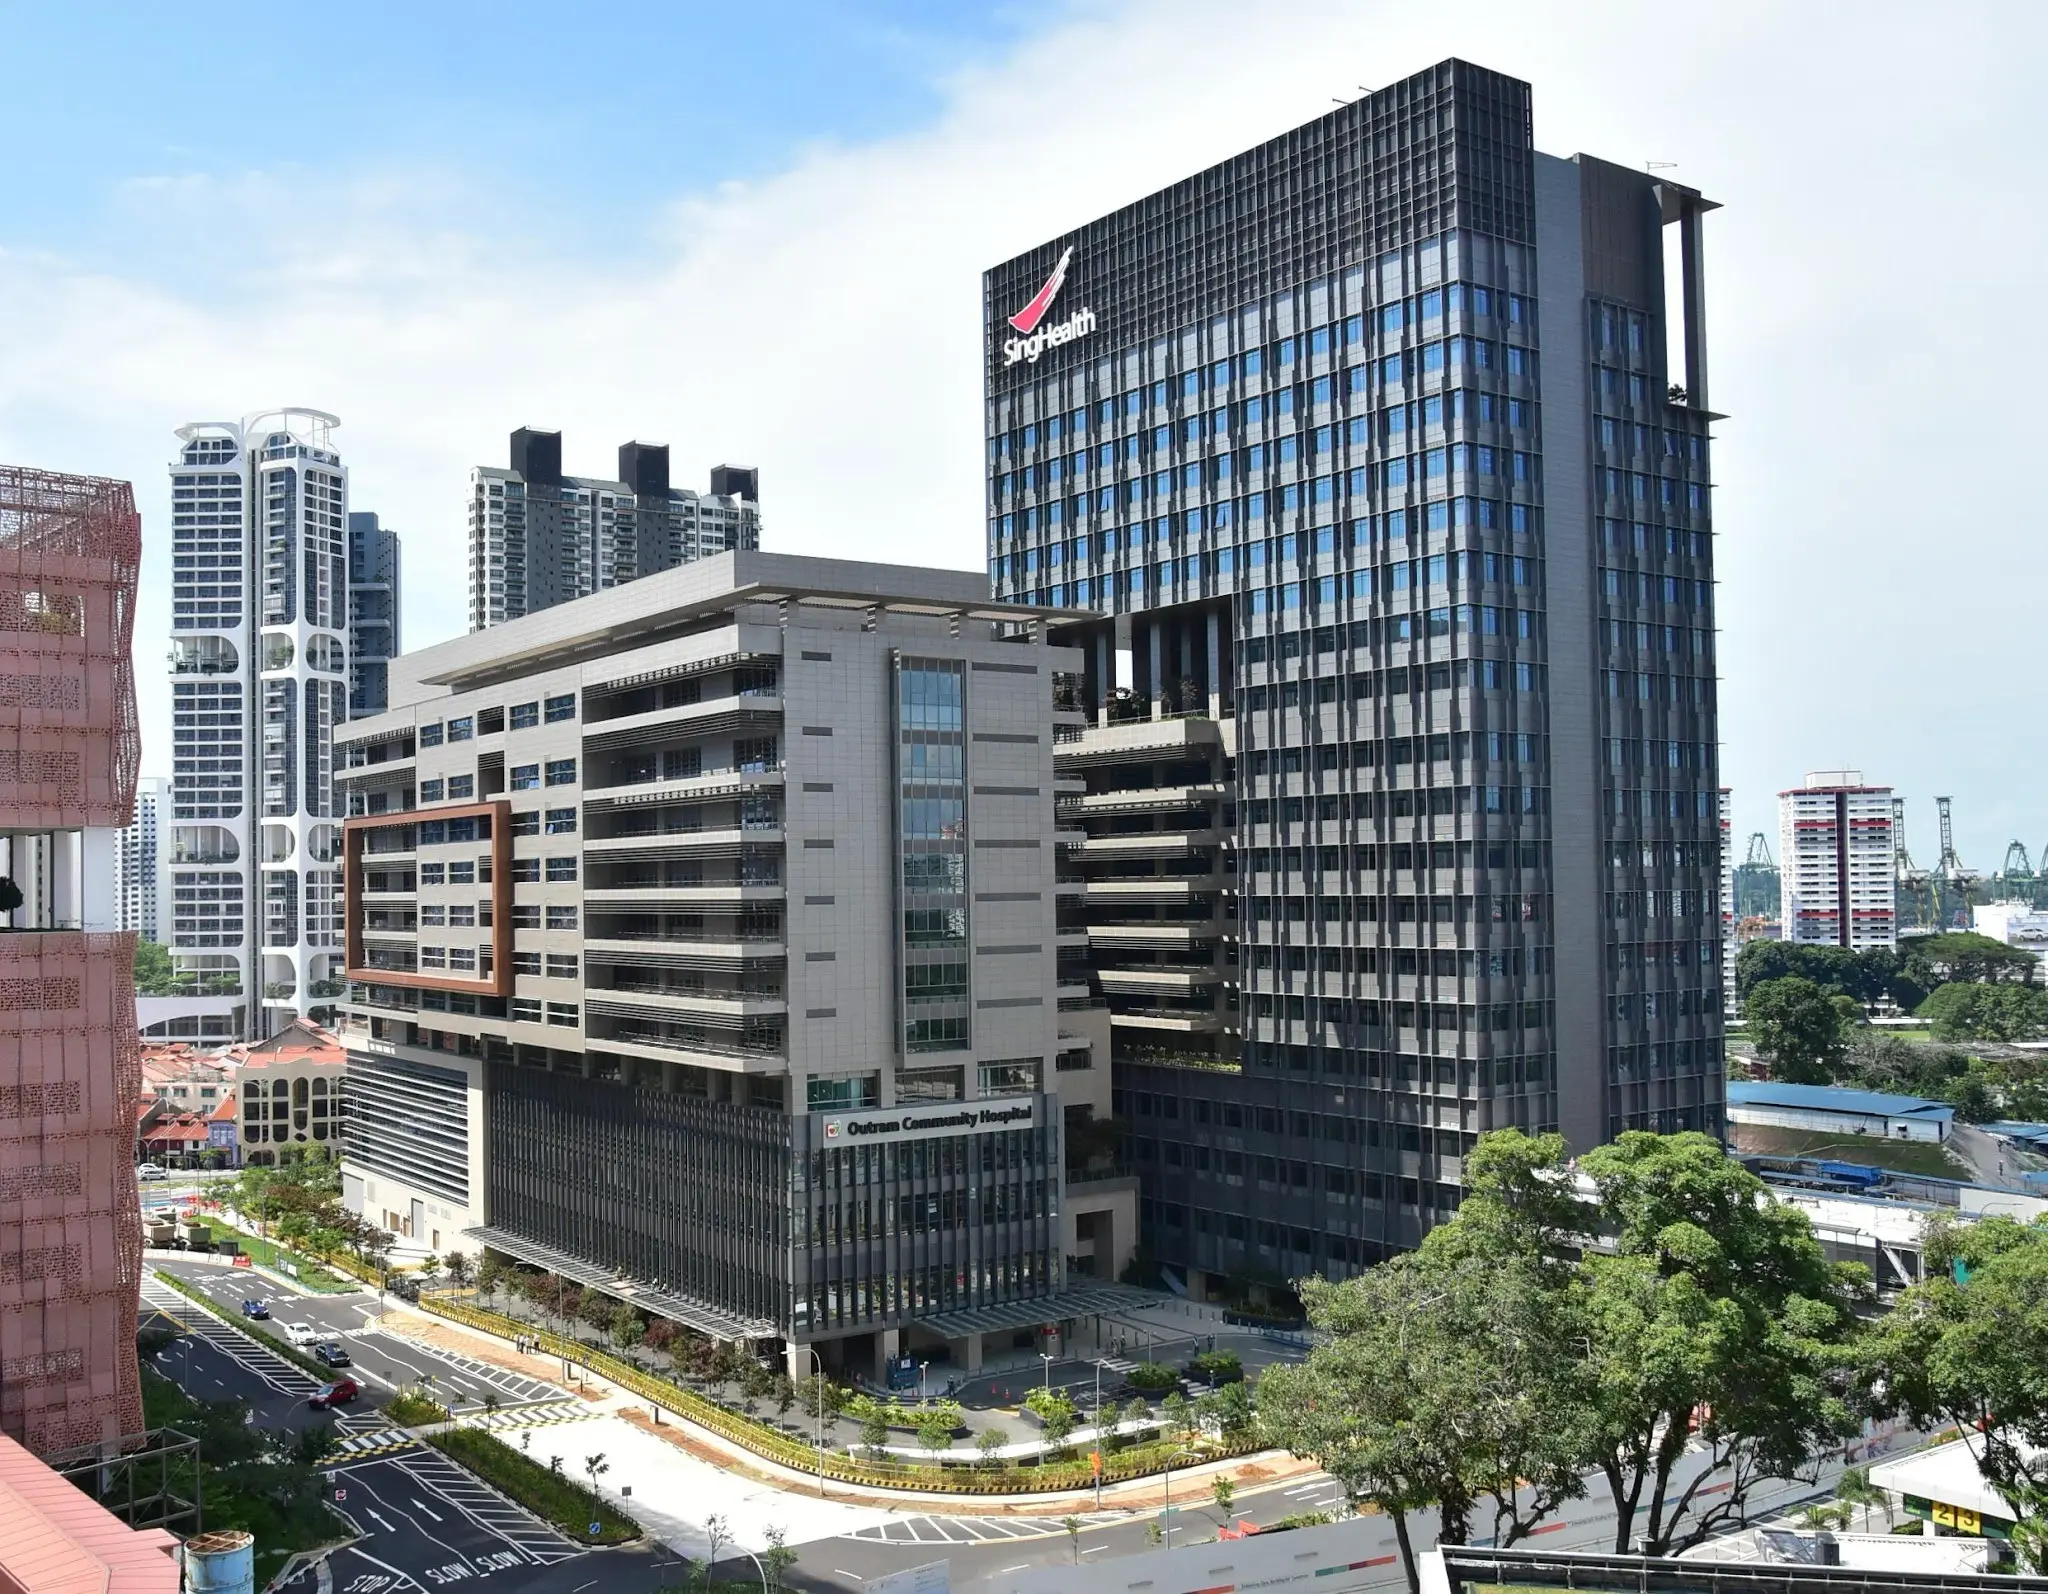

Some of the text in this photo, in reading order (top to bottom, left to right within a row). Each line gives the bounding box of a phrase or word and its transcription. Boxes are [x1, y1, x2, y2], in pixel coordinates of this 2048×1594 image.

[1004, 307, 1096, 366] SingHealth
[848, 1105, 1032, 1136] Outram Community Hospital
[475, 1551, 523, 1571] SLOW
[343, 1574, 391, 1593] STOP
[425, 1562, 473, 1584] SLOW
